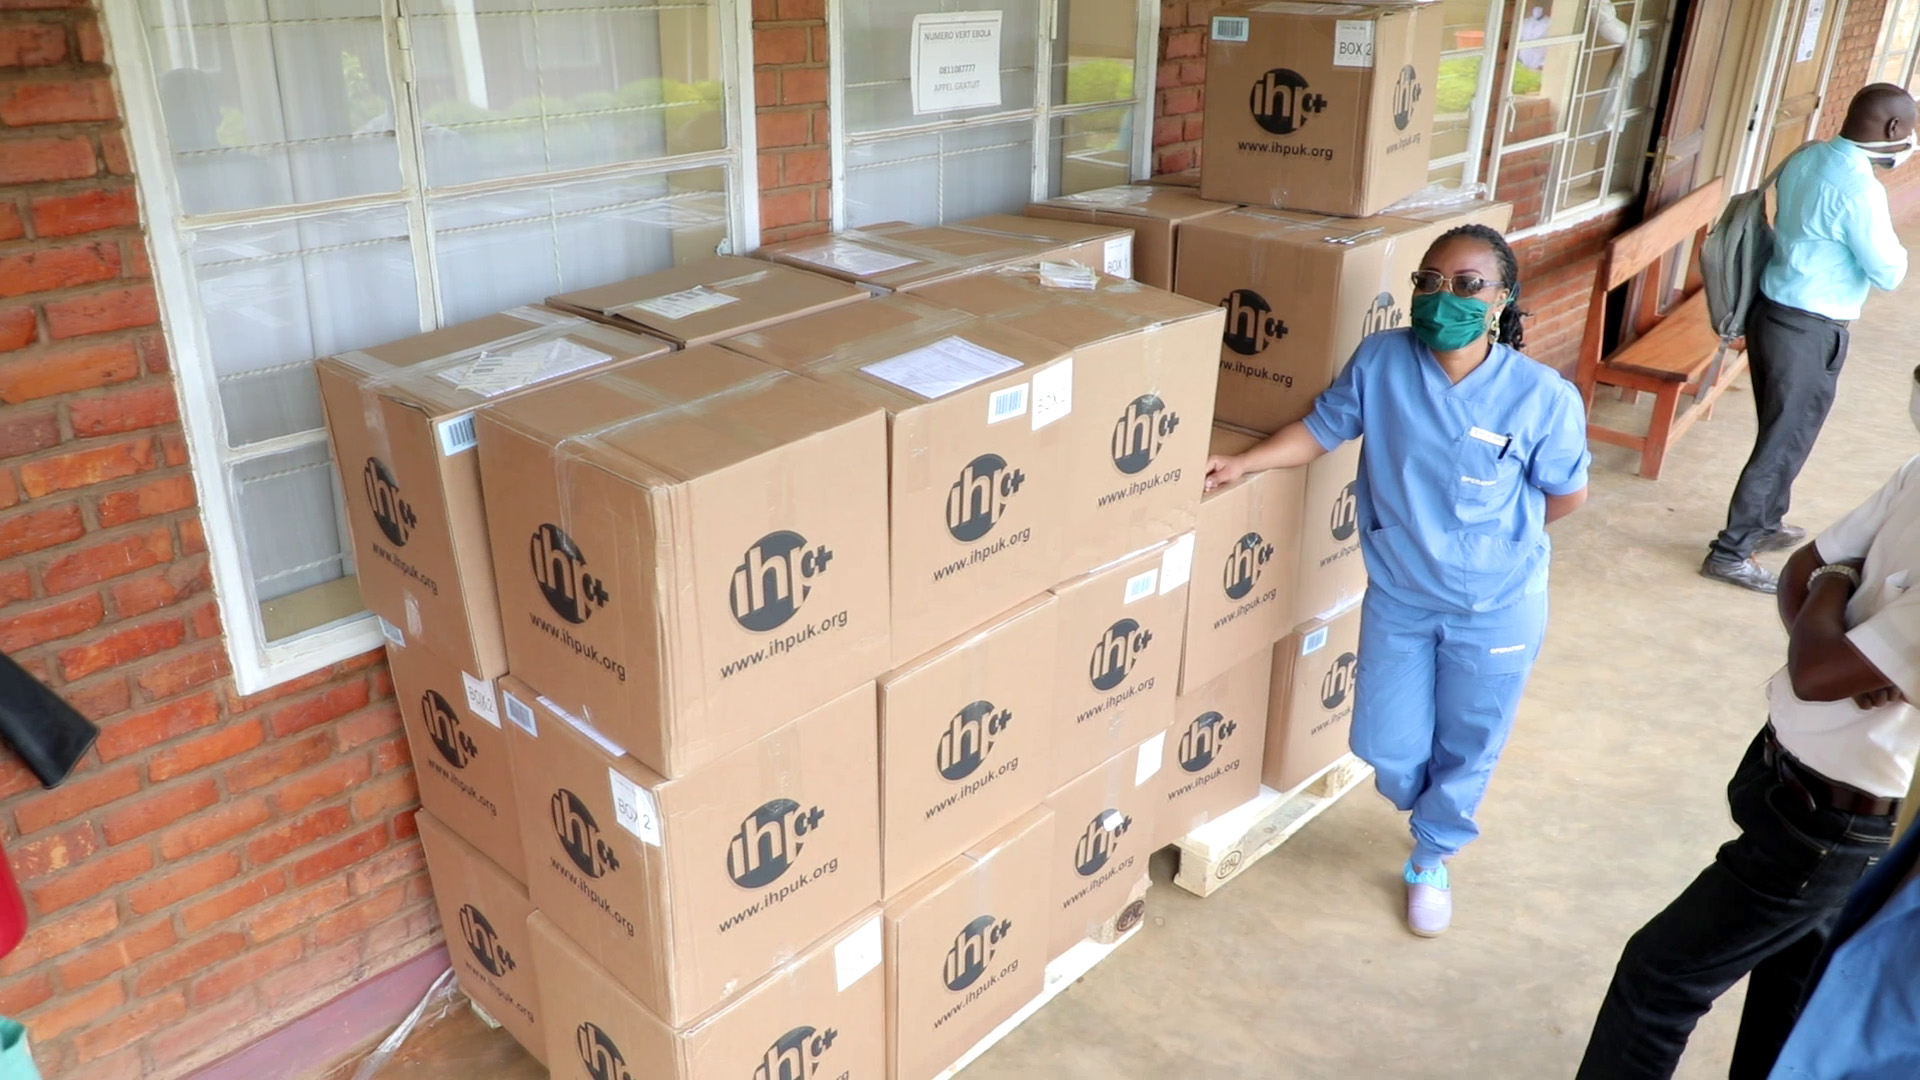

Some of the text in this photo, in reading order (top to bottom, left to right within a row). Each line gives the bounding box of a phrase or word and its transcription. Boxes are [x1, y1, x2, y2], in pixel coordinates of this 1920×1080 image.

[955, 29, 971, 39] VERT
[972, 29, 992, 39] EBOLA
[1339, 41, 1372, 56] BOX 2
[933, 80, 981, 93] APPEL GRATUIT
[1238, 141, 1334, 161] www.ihpuk.org
[1220, 359, 1294, 389] w.ihpuk.org
[1097, 467, 1182, 508] www.ihpuk.org
[932, 527, 1031, 582] www.ihpuk.org
[1212, 588, 1277, 631] www.ihpuk.org
[530, 612, 627, 682] www.ihpuk.org
[720, 609, 848, 679] www.ihpuk.org
[1076, 677, 1156, 724] www.ihpuk.org
[924, 757, 1019, 819] www.ihpuk.org
[1167, 759, 1241, 801] www.ihpuk.org
[643, 814, 652, 830] 2
[550, 856, 635, 938] www.ihpuk.org
[718, 857, 839, 933] www.ihpuk.org
[1062, 855, 1135, 909] www.ihpuk.org
[933, 959, 1019, 1029] www.ihpuk.org
